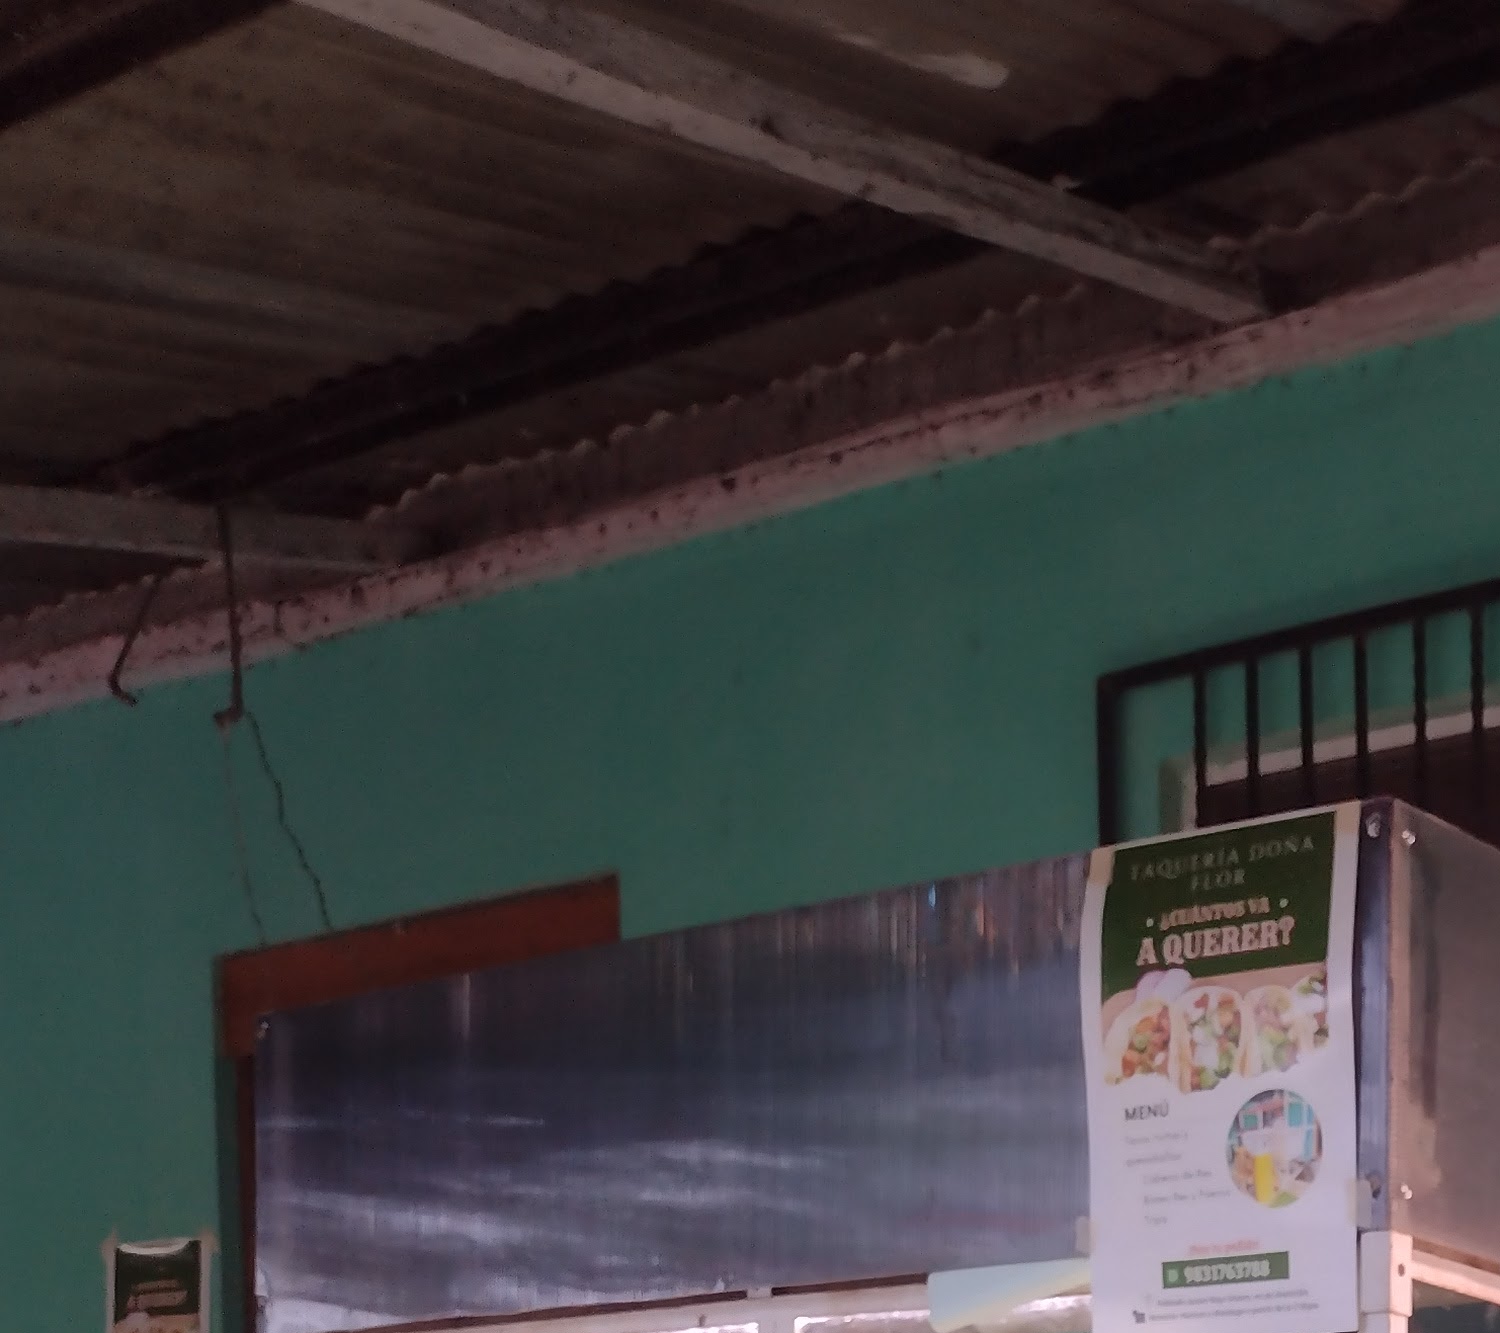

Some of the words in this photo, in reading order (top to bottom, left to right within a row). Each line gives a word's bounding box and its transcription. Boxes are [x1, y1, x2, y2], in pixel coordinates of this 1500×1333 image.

[1191, 869, 1245, 890] FLOR
[1136, 938, 1156, 966] A
[1162, 915, 1295, 964] QUERER?
[1124, 1101, 1169, 1121] MENÚ
